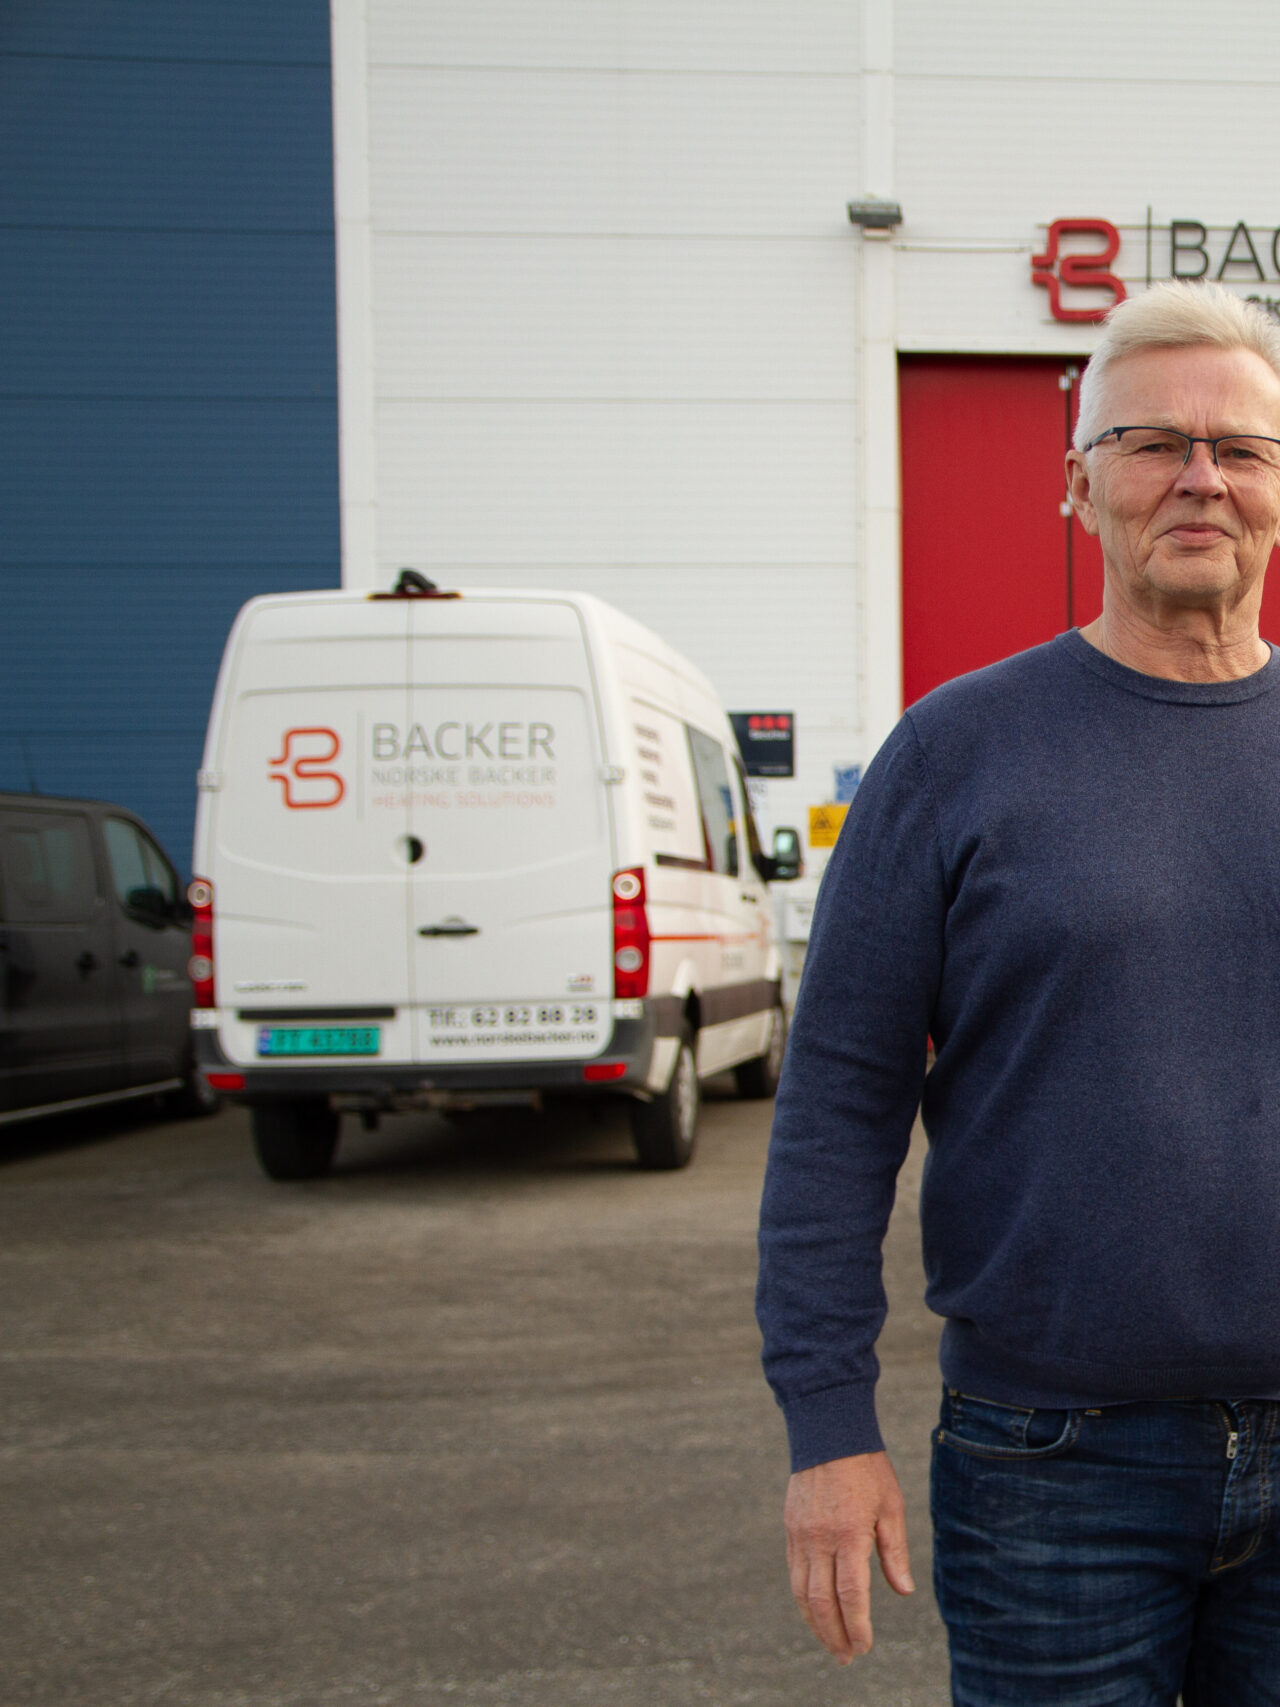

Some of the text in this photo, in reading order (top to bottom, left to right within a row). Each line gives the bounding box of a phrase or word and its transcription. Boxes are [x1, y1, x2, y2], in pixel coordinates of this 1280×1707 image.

[371, 721, 556, 761] BACKER
[371, 766, 557, 787] NORSKE BACKER
[371, 790, 556, 809] HEATING SOLUTIONS
[471, 1007, 499, 1028] 62
[503, 1006, 531, 1027] 82
[569, 1004, 598, 1025] 28
